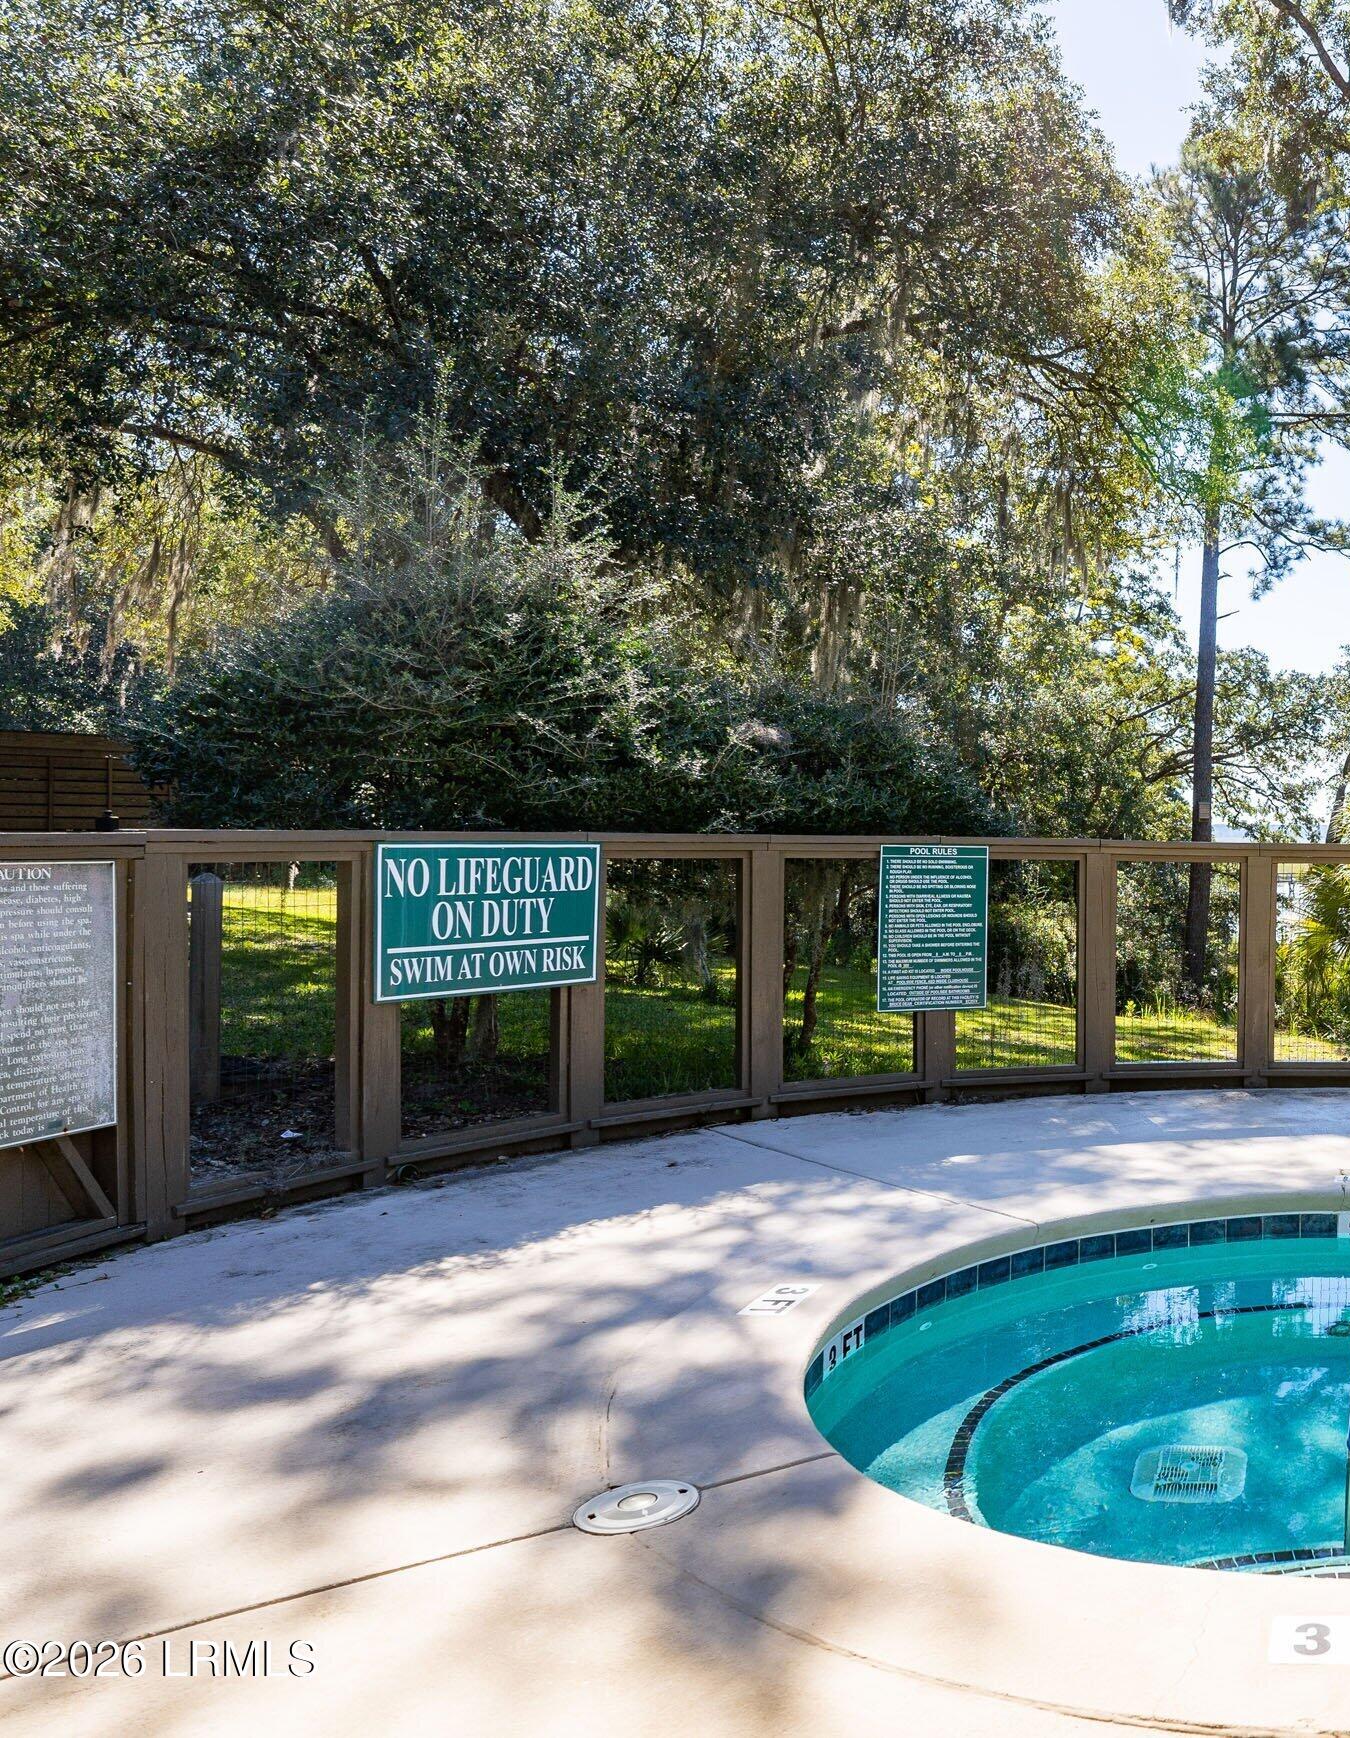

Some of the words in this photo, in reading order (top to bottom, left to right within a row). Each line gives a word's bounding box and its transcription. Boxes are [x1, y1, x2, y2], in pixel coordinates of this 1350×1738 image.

[384, 858, 430, 898] NO
[437, 856, 593, 896] LIFEGUARD
[11, 883, 26, 892] and
[29, 883, 50, 891] those
[53, 882, 87, 891] suffering
[26, 895, 61, 904] diabetes,
[64, 894, 81, 904] high
[0, 908, 34, 918] pressure
[37, 906, 63, 915] should
[66, 904, 93, 913] consult
[9, 920, 34, 928] before
[37, 918, 59, 928] using
[62, 917, 74, 925] the
[432, 901, 474, 940] ON
[481, 897, 555, 937] DUTY
[11, 933, 24, 941] spa
[28, 930, 50, 939] while
[54, 928, 76, 937] under
[79, 927, 92, 936] the
[0, 945, 28, 954] lcohol,
[390, 955, 453, 986] SWIM
[457, 953, 485, 980] AT
[489, 949, 537, 977] OWN
[541, 946, 586, 972] RISK
[49, 976, 75, 986] should
[16, 1003, 43, 1013] should
[7, 1029, 30, 1041] spend
[27, 1042, 35, 1050] in
[8, 1056, 28, 1066] Long
[6, 1076, 57, 1090] temperature
[39, 1086, 48, 1096] of
[51, 1082, 78, 1094] Health
[38, 1099, 49, 1108] for
[10, 1111, 60, 1126] temperature
[62, 1106, 71, 1115] of
[13, 1126, 34, 1137] today
[829, 1345, 837, 1371] 3
[842, 1323, 863, 1360] FT
[1293, 1623, 1331, 1656] 3
